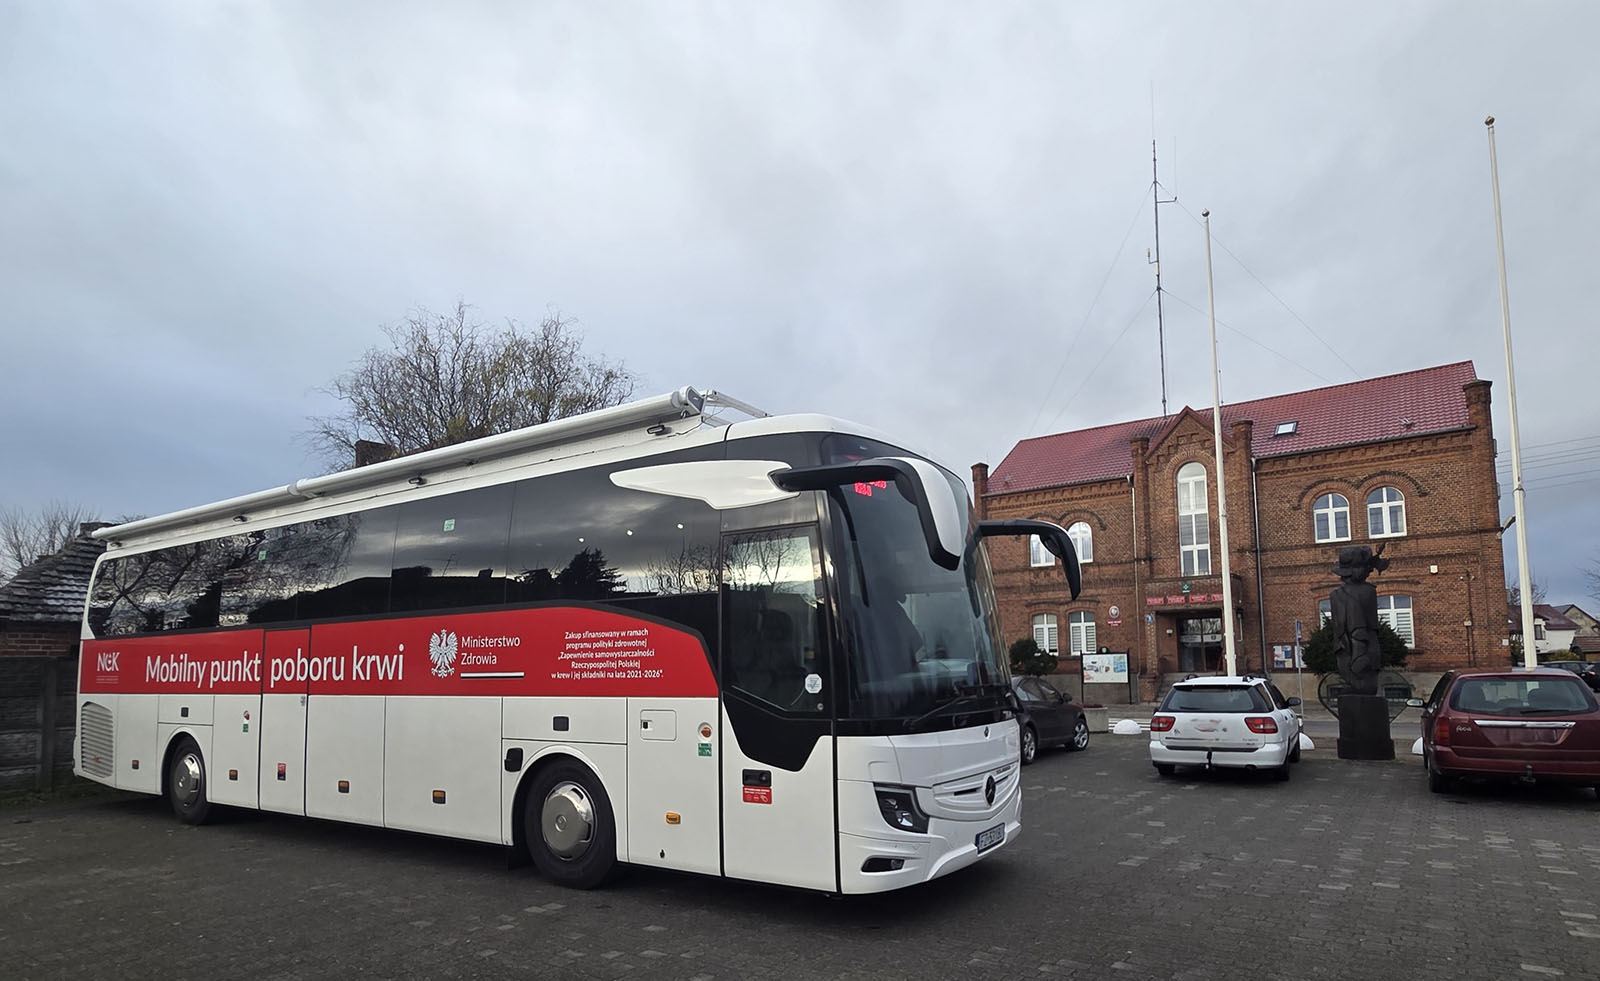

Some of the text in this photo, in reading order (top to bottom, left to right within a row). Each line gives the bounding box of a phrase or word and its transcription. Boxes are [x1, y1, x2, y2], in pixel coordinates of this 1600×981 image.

[565, 631, 581, 640] Zakup
[582, 630, 620, 639] sfinansowany
[626, 628, 648, 637] ramach
[461, 635, 521, 648] Ministerstwo
[566, 638, 647, 650] programu polityki zdrowotnej
[460, 652, 497, 665] Zdrowia
[594, 649, 655, 659] samowystarczalności
[145, 643, 405, 689] Mobilny punkt poboru krwi
[571, 660, 641, 670] Rzeczypospolitej Polskiej
[556, 671, 571, 679] krew
[573, 671, 581, 680] jej
[581, 670, 606, 679] składniki
[614, 670, 626, 678] lata
